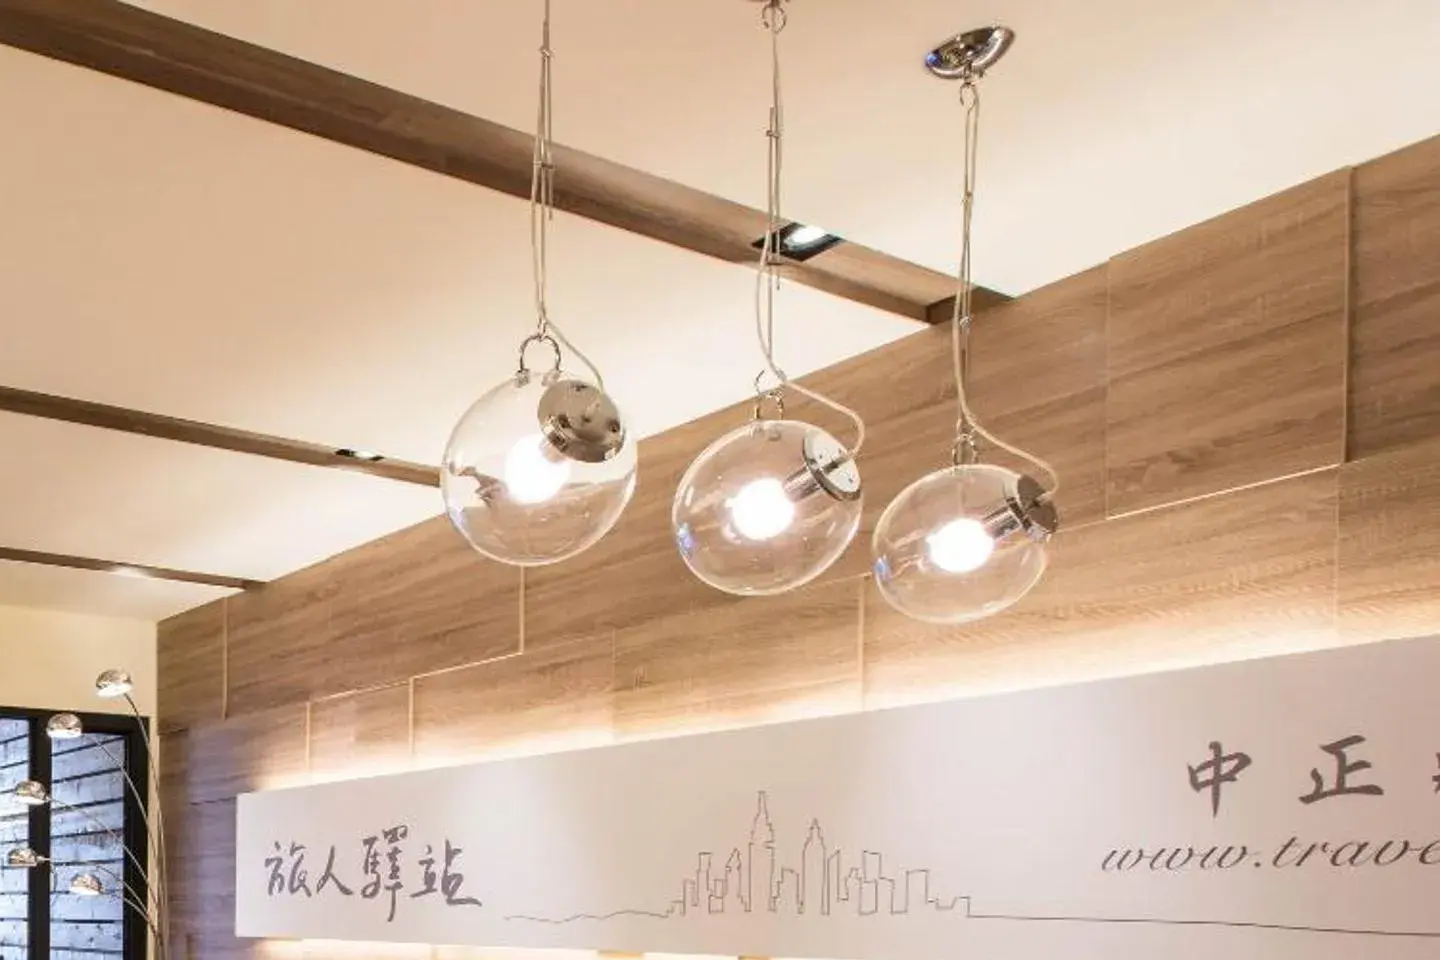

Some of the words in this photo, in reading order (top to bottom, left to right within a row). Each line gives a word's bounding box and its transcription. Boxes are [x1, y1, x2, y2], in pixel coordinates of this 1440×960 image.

[1187, 735, 1440, 818] 中正
[264, 825, 482, 922] 旅人驛站
